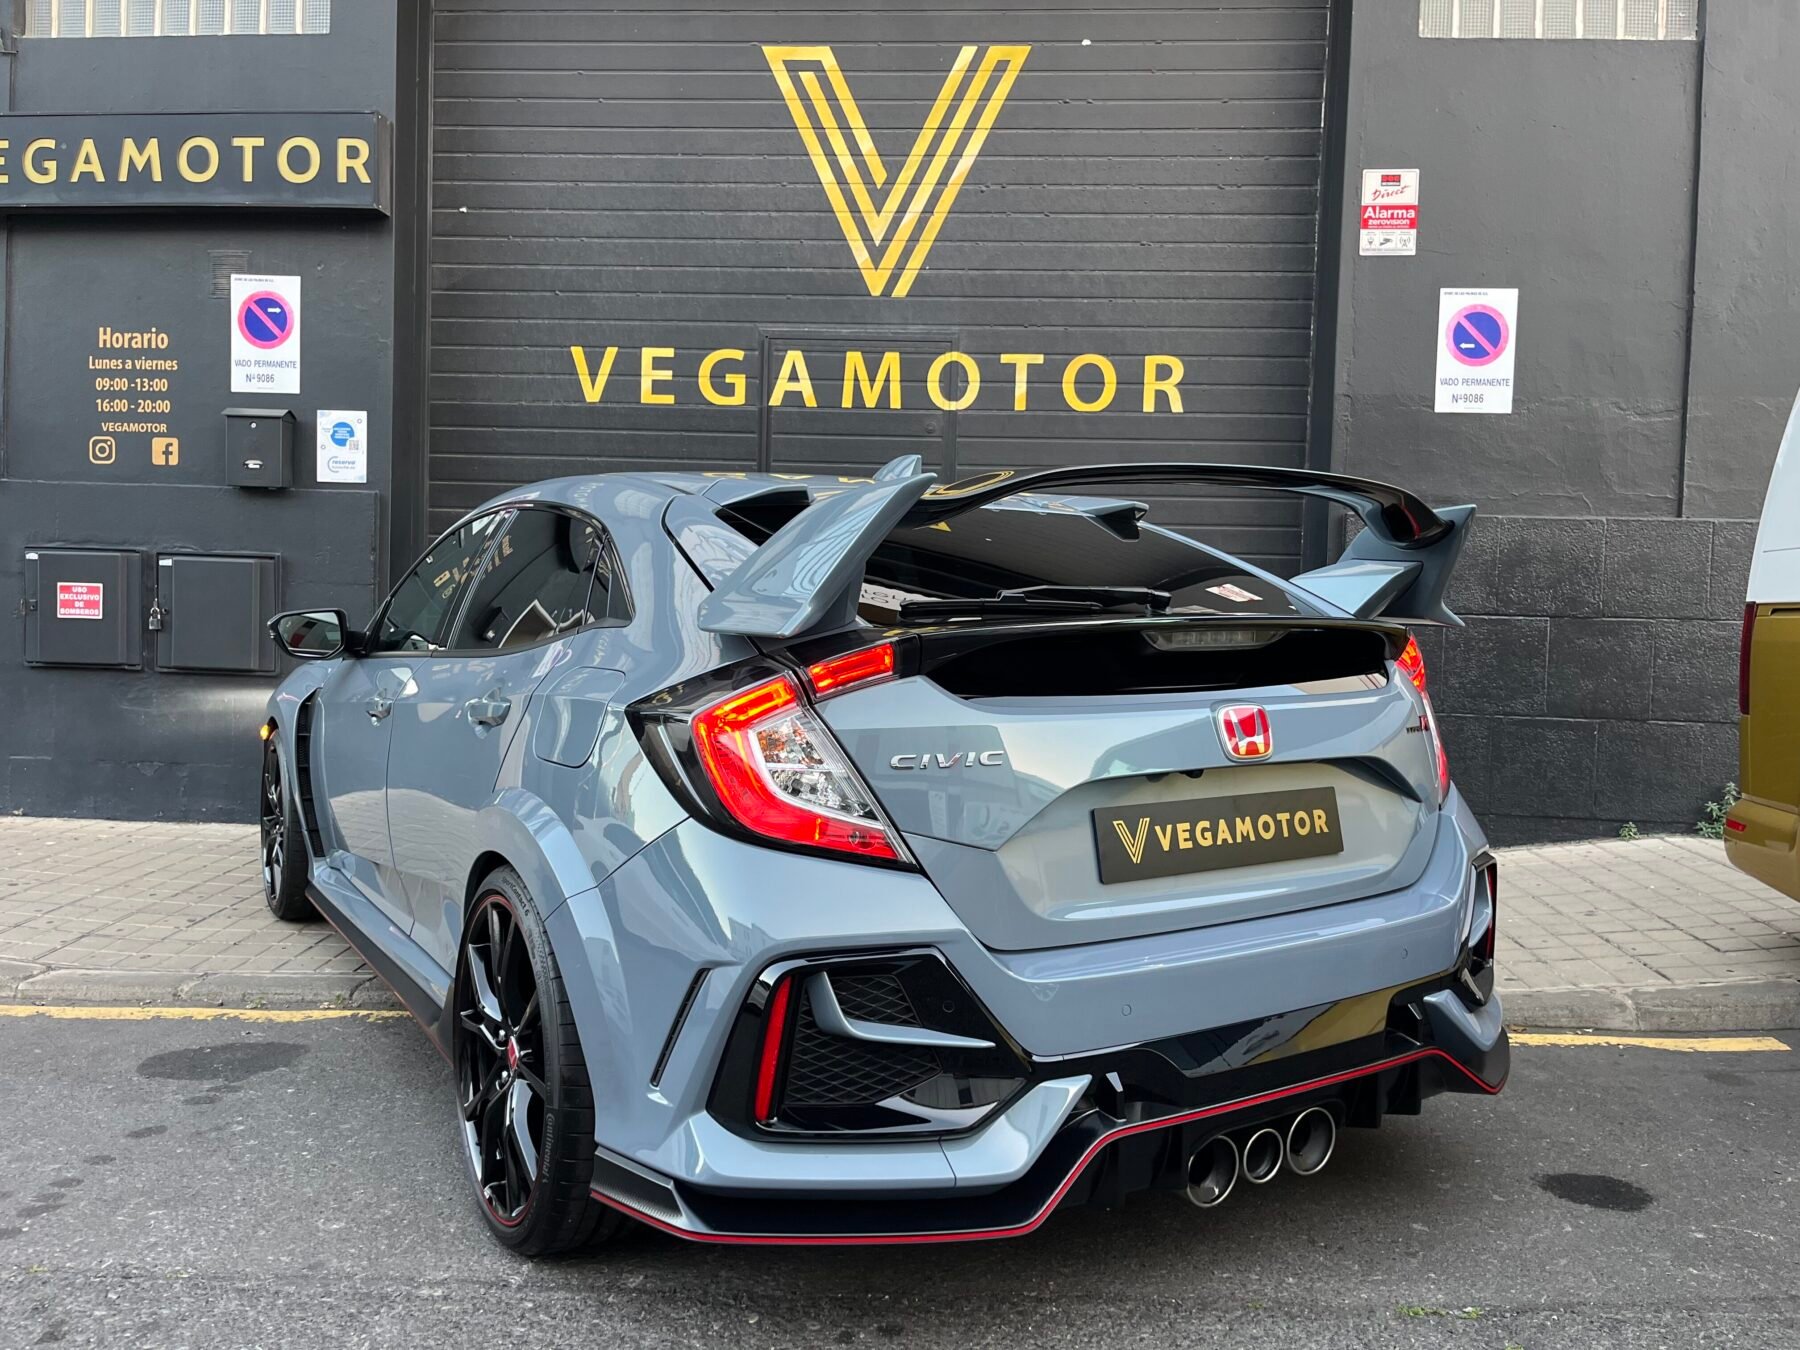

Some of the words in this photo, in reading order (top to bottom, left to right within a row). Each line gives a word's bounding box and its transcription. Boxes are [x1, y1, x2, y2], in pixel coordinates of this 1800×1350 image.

[1364, 206, 1415, 219] Alarma
[98, 327, 169, 349] Horario
[89, 355, 122, 370] Lunes
[125, 360, 132, 370] a
[135, 356, 178, 371] viernes
[234, 359, 252, 368] VADO
[253, 359, 297, 369] PERMANENTE
[95, 377, 128, 391] 09:00
[570, 346, 1185, 414] VEGAMOTOR
[1440, 378, 1459, 386] VADO
[1461, 378, 1511, 387] PERMANENTE
[96, 398, 128, 412] 16:00
[137, 400, 171, 413] 20:00
[101, 422, 167, 433] VEGAMOTOR
[59, 593, 99, 601] EXCLUSIVO
[890, 750, 1004, 769] CIVIC
[1154, 809, 1329, 851] VEGAMOTOR
[542, 1112, 555, 1177] Continental
